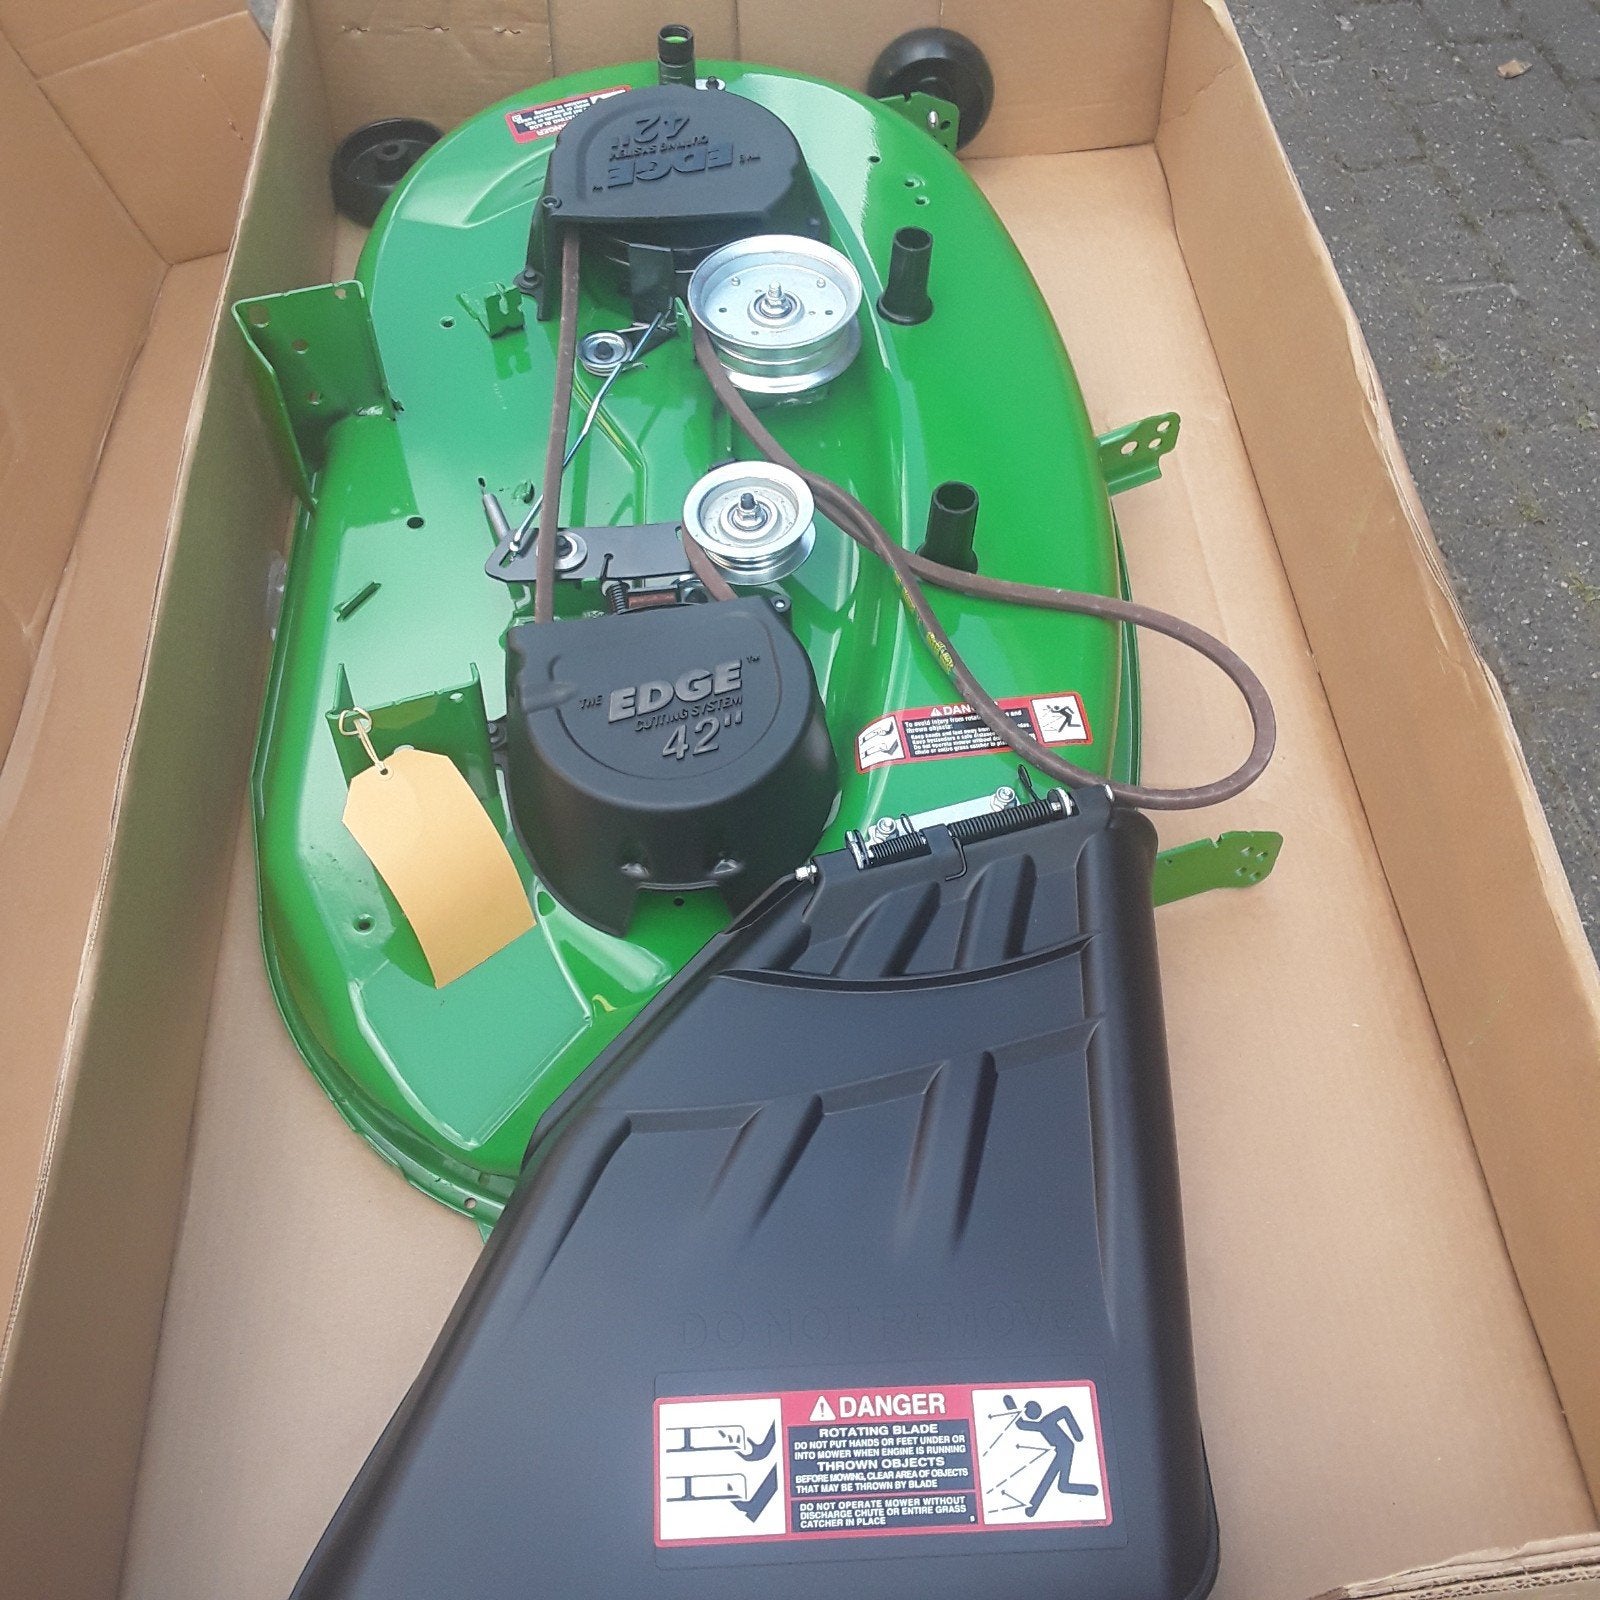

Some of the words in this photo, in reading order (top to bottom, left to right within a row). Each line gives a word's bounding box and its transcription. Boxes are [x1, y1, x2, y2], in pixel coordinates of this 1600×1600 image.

[536, 123, 568, 136] ANGER
[660, 136, 708, 152] CUTTING
[609, 145, 657, 162] SYSTEM
[608, 142, 733, 189] EDGE
[579, 695, 602, 710] THE
[608, 657, 742, 723] EDGE
[635, 709, 688, 731] CUTTING
[691, 696, 743, 716] SYSTEM
[839, 1392, 946, 1418] DANGER
[819, 1425, 888, 1438] ROTATING
[893, 1423, 938, 1435] BLADE
[794, 1441, 807, 1450] DO
[809, 1440, 828, 1449] NOT
[830, 1439, 847, 1448] PUT
[849, 1438, 879, 1448] HANDS
[882, 1437, 894, 1446] OR
[896, 1436, 918, 1445] FEET
[920, 1435, 950, 1444] UNDER
[952, 1435, 965, 1443] OR
[795, 1450, 815, 1460] INTO
[818, 1449, 851, 1459] MOWER
[853, 1448, 880, 1458] WHEN
[882, 1446, 914, 1456] ENGINE
[916, 1446, 925, 1455] IS
[927, 1445, 966, 1454] RUNNING
[817, 1458, 878, 1471] THROWN
[882, 1457, 945, 1468] OBJECTS
[796, 1474, 829, 1483] BEFORE
[830, 1473, 866, 1482] MOWING,
[867, 1472, 893, 1481] CLEAR
[895, 1470, 918, 1479] AREA
[919, 1470, 930, 1478] OF
[932, 1468, 968, 1477] OBJECTS
[796, 1485, 818, 1494] THAT
[821, 1484, 839, 1492] MAY
[841, 1483, 853, 1492] BE
[855, 1481, 893, 1490] THROWN
[895, 1480, 906, 1489] BY
[908, 1479, 937, 1488] BLADE
[800, 1503, 813, 1511] DO
[816, 1502, 835, 1511] NOT
[839, 1500, 882, 1509] OPERATE
[885, 1498, 920, 1507] MOWER
[923, 1496, 965, 1506] WITHOUT
[801, 1510, 852, 1520] DISCHARGE
[855, 1508, 884, 1517] CHUTE
[887, 1507, 899, 1516] OR
[902, 1505, 933, 1515] ENTIRE
[935, 1504, 966, 1514] GRASS
[800, 1519, 844, 1528] CATCHER
[846, 1518, 854, 1526] IN
[857, 1517, 886, 1525] PLACE
